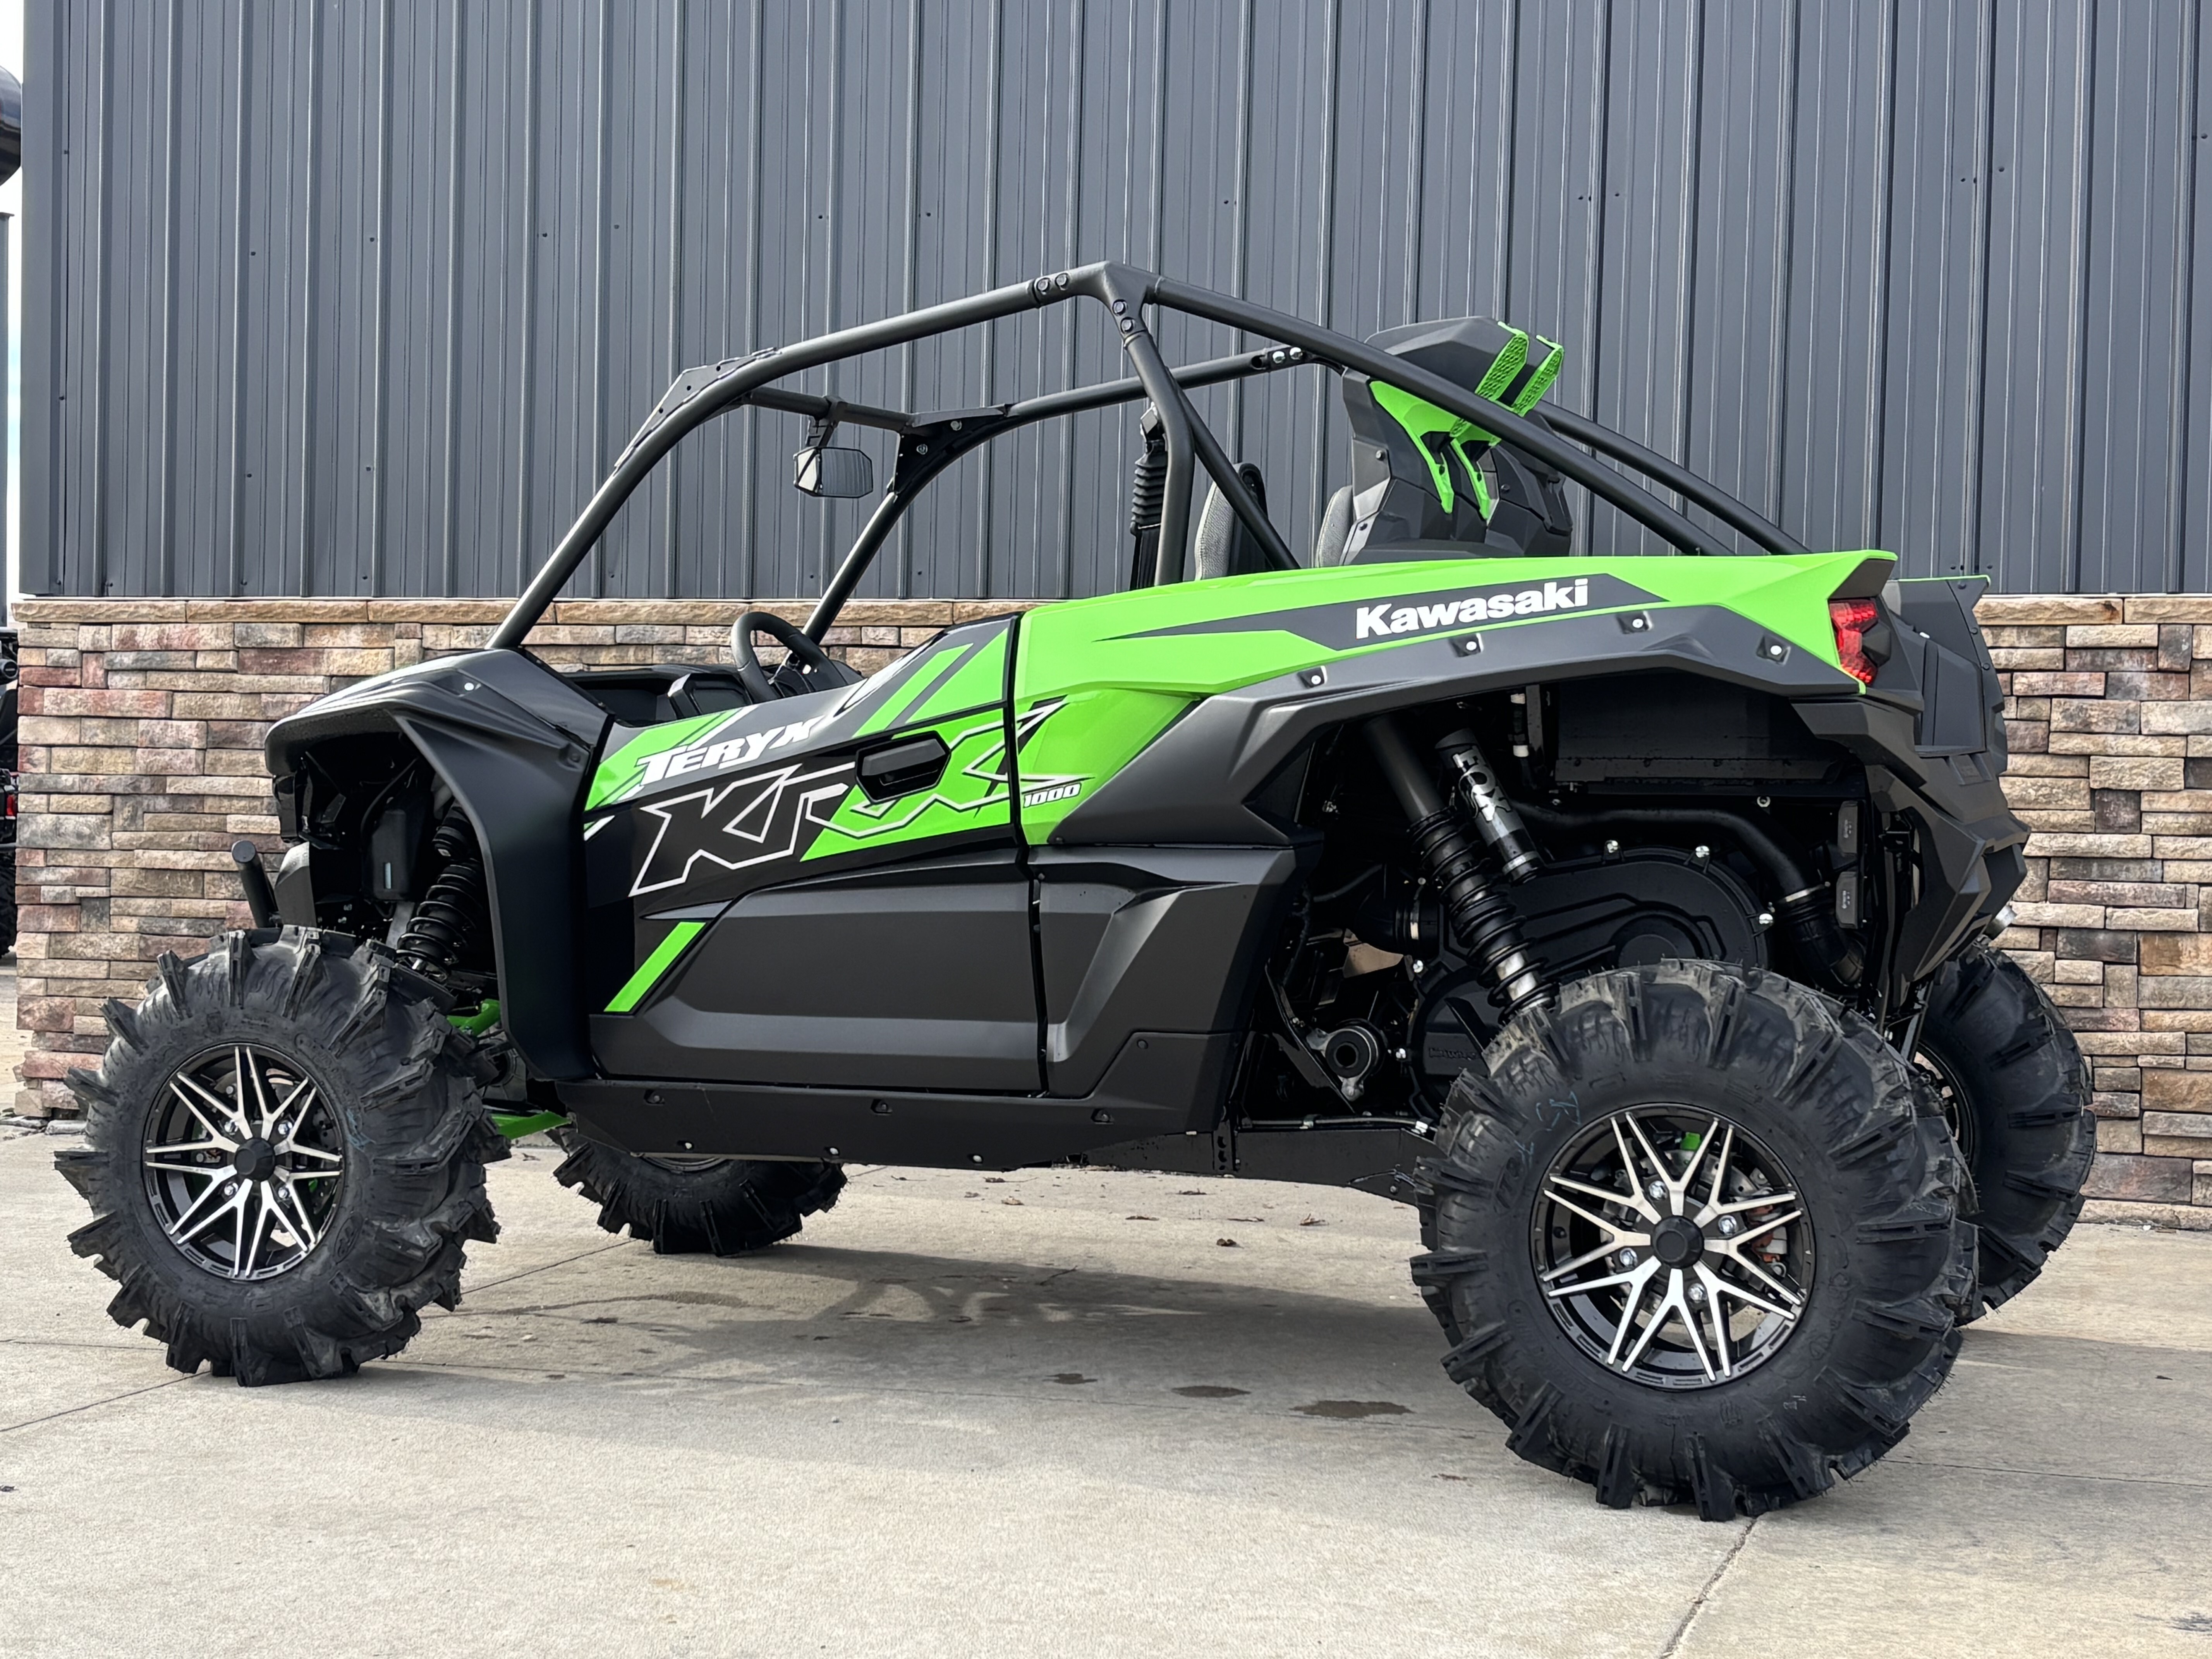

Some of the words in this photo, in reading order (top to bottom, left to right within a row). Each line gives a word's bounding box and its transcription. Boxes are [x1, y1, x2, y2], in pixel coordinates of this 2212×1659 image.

[1356, 578, 1589, 639] Kawasaki
[635, 715, 826, 786] TERYX
[1452, 745, 1511, 822] FOX
[1023, 782, 1082, 808] 1000
